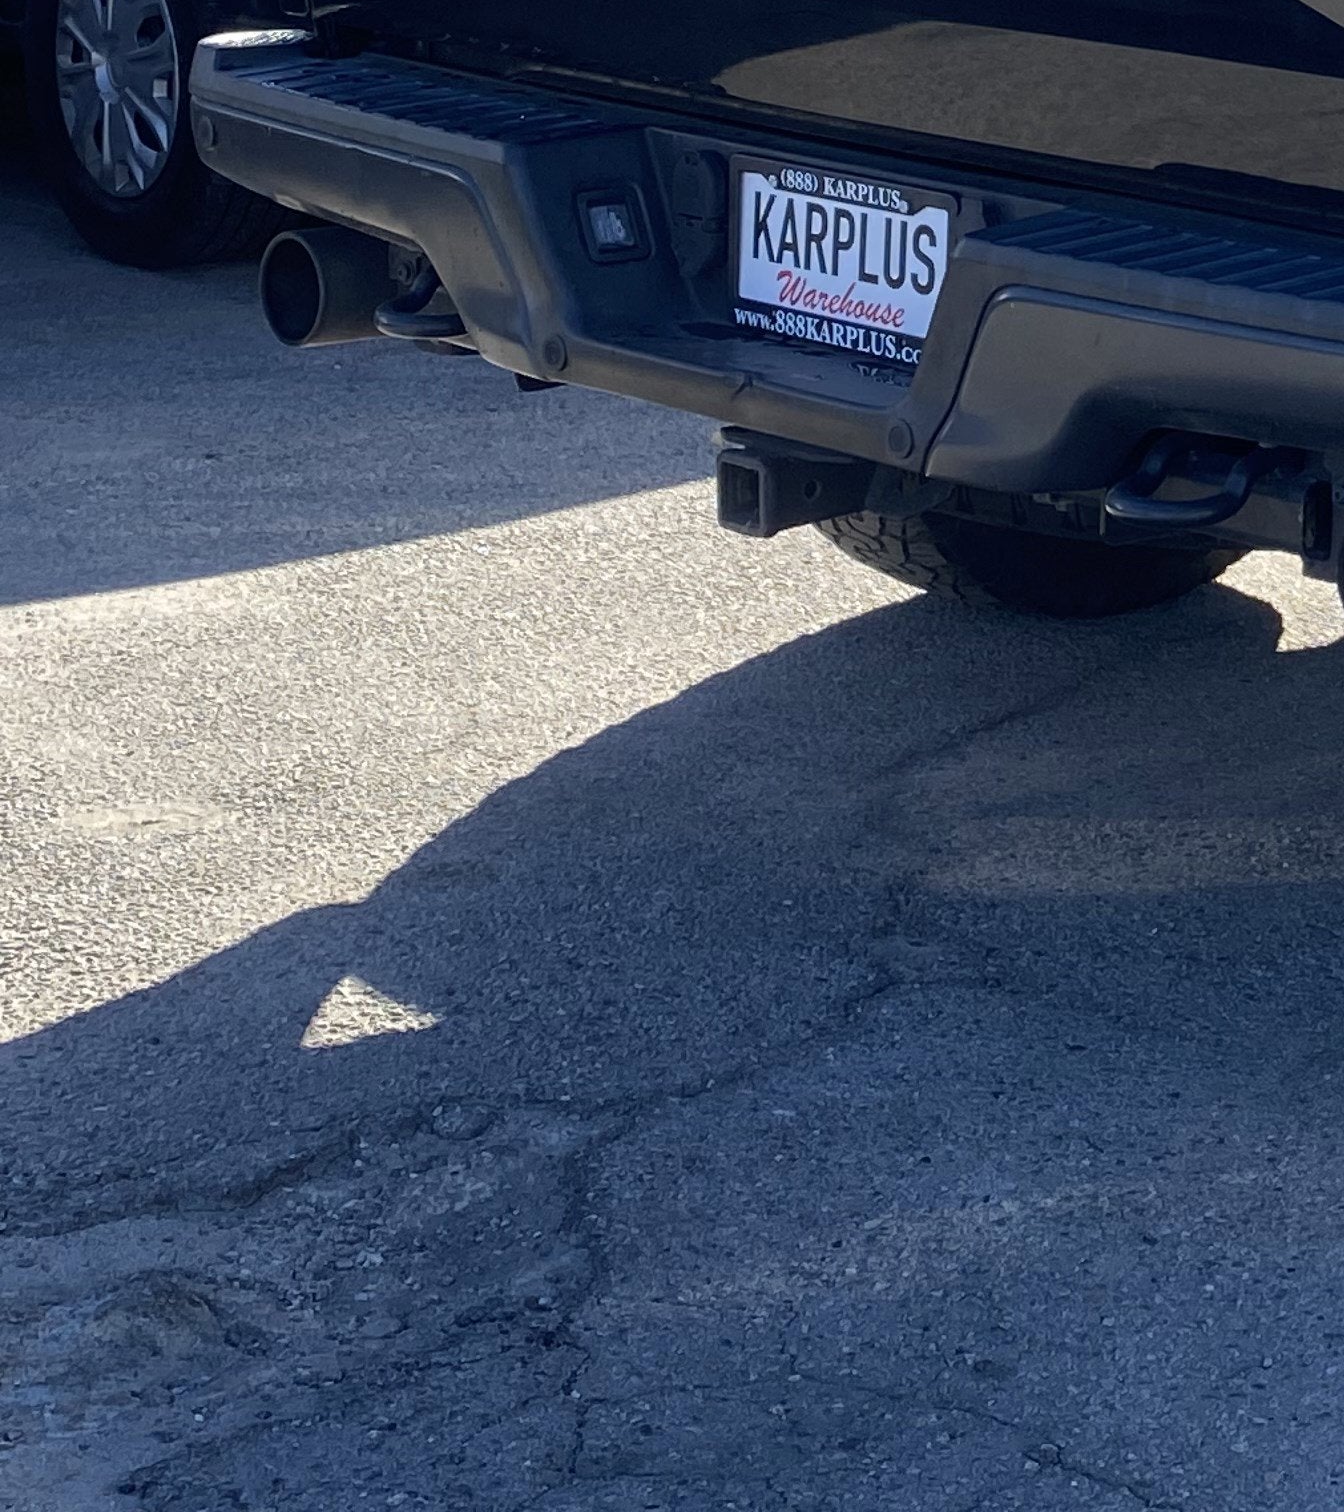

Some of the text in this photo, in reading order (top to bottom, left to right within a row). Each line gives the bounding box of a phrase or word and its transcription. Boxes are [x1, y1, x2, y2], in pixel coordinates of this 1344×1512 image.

[780, 168, 901, 210] (888) KARPLUS
[753, 190, 937, 295] KARPLUS
[777, 269, 906, 328] Warehouse
